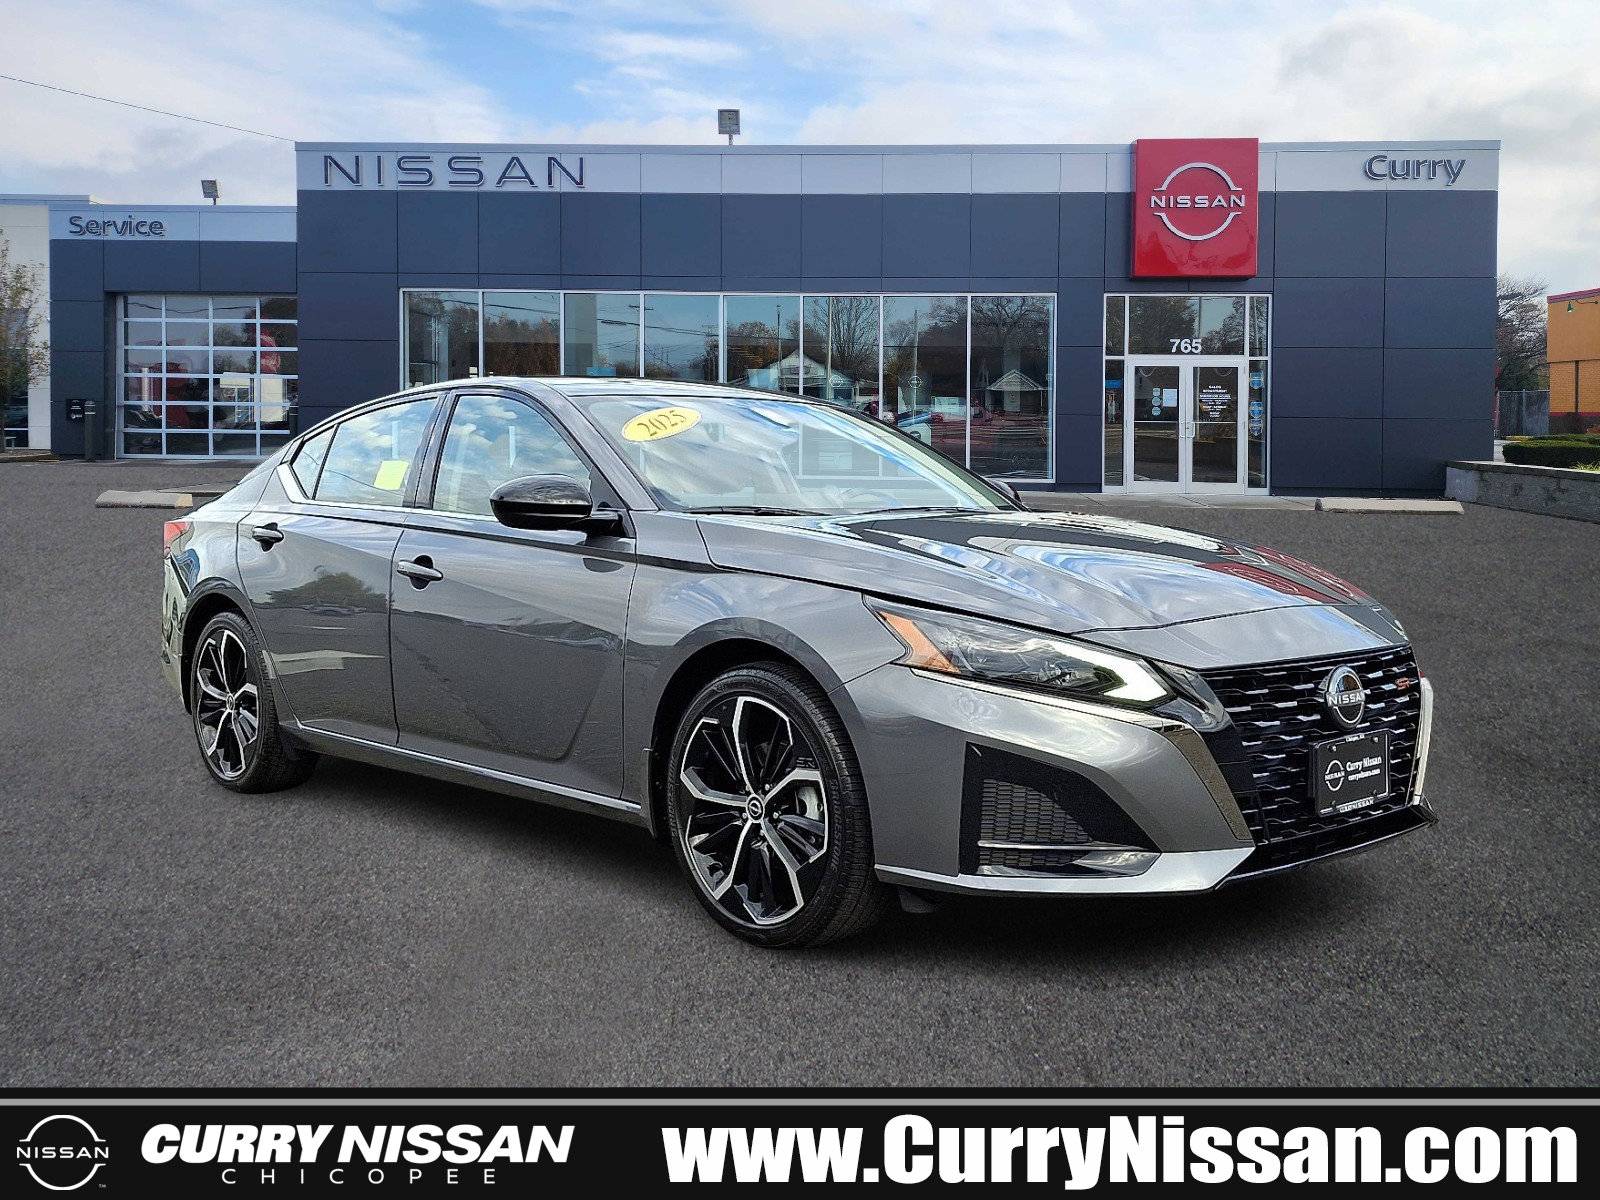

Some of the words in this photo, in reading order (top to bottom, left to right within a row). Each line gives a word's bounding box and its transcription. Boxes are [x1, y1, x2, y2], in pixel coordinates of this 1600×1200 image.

[324, 155, 586, 189] NISSAN
[1365, 155, 1466, 187] Curry
[1150, 194, 1245, 208] NISSAN
[69, 214, 165, 236] Service
[1170, 338, 1202, 353] 765
[637, 410, 687, 437] 2025
[1346, 761, 1363, 772] Curry
[1363, 756, 1382, 768] Nissan
